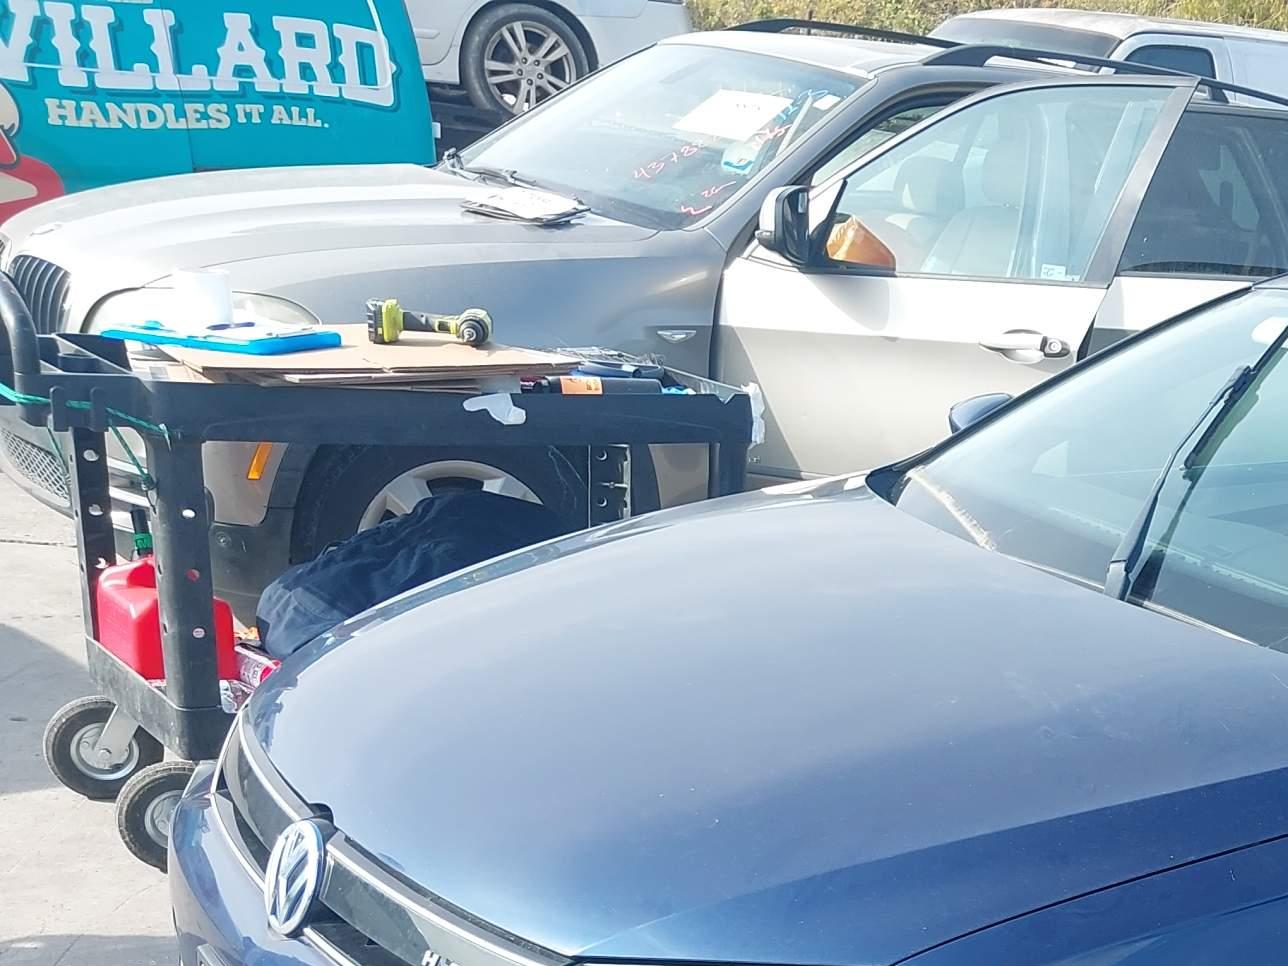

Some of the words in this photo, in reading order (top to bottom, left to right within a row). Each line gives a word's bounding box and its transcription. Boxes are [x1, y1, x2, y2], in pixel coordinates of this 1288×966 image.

[45, 98, 231, 129] HANDLES
[236, 103, 265, 124] IT
[271, 105, 330, 128] ALL.
